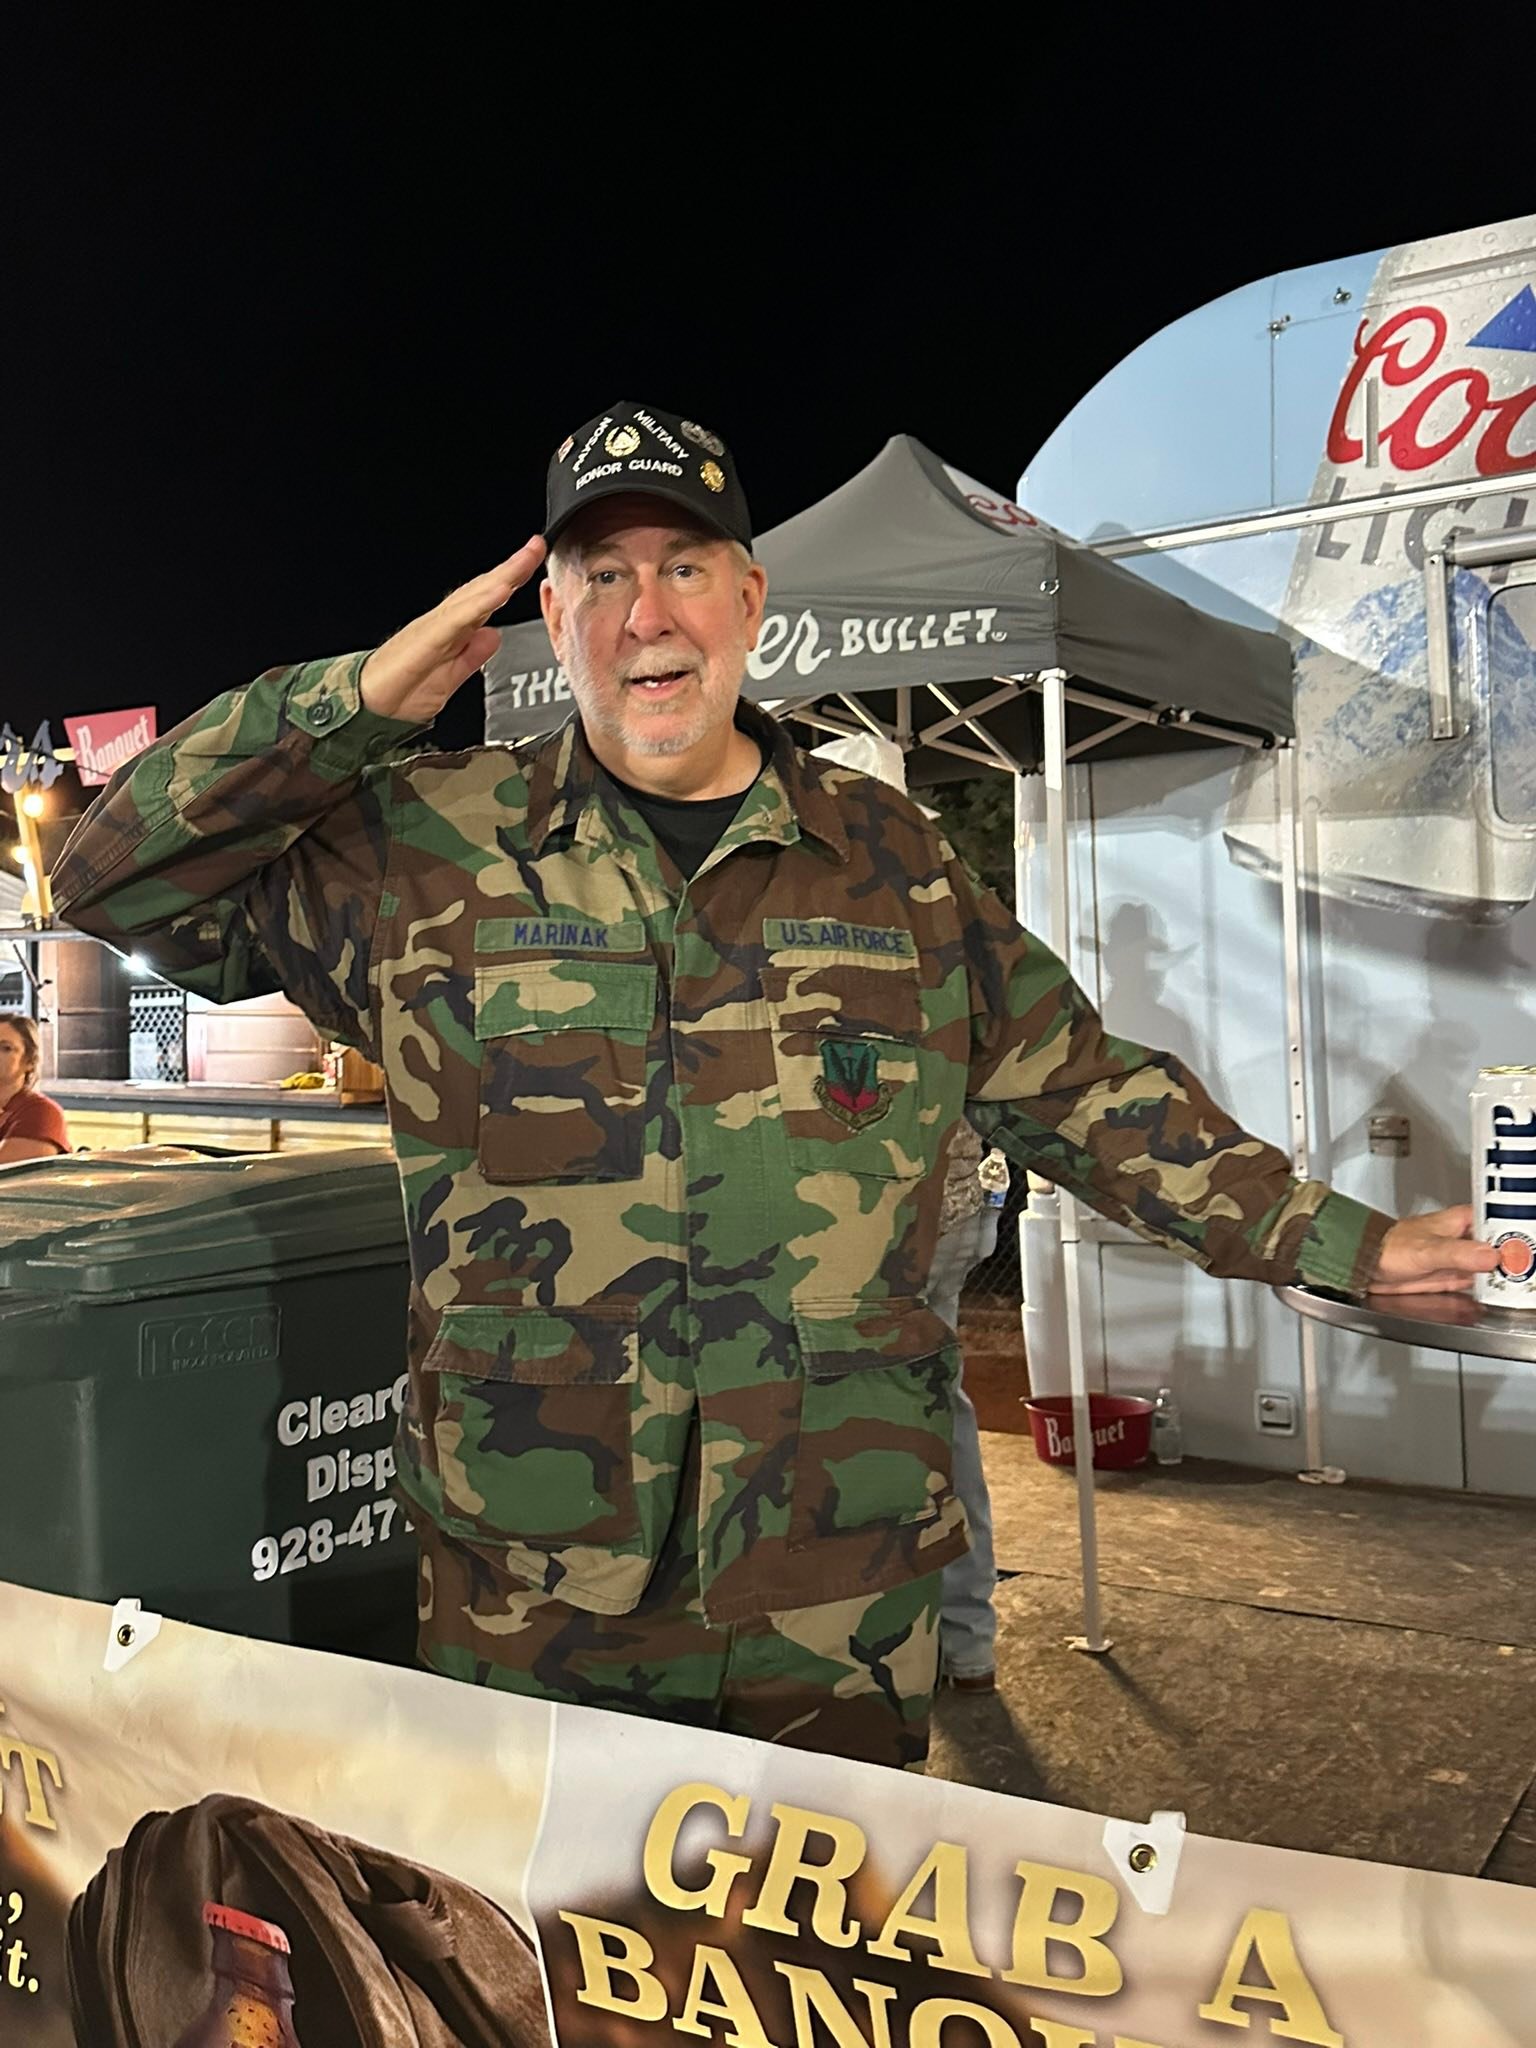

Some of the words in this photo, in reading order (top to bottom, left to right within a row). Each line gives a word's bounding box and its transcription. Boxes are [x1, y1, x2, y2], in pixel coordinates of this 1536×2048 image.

[633, 410, 689, 459] MILITARY
[576, 461, 622, 491] HONOR
[628, 458, 683, 477] GUARD
[1315, 477, 1528, 584] LIG
[511, 667, 572, 709] THE
[840, 608, 997, 656] BULLET
[513, 923, 608, 949] MARINAK
[781, 922, 817, 946] U.S.
[819, 924, 848, 948] AIR
[851, 927, 905, 954] FORCE
[1044, 1417, 1125, 1457] Bauet
[307, 1448, 397, 1502] Disp
[251, 1497, 415, 1582] 928-47
[641, 1782, 1124, 1997] GRAB
[1199, 1908, 1345, 2048] A
[558, 1910, 1168, 2048] BAN
